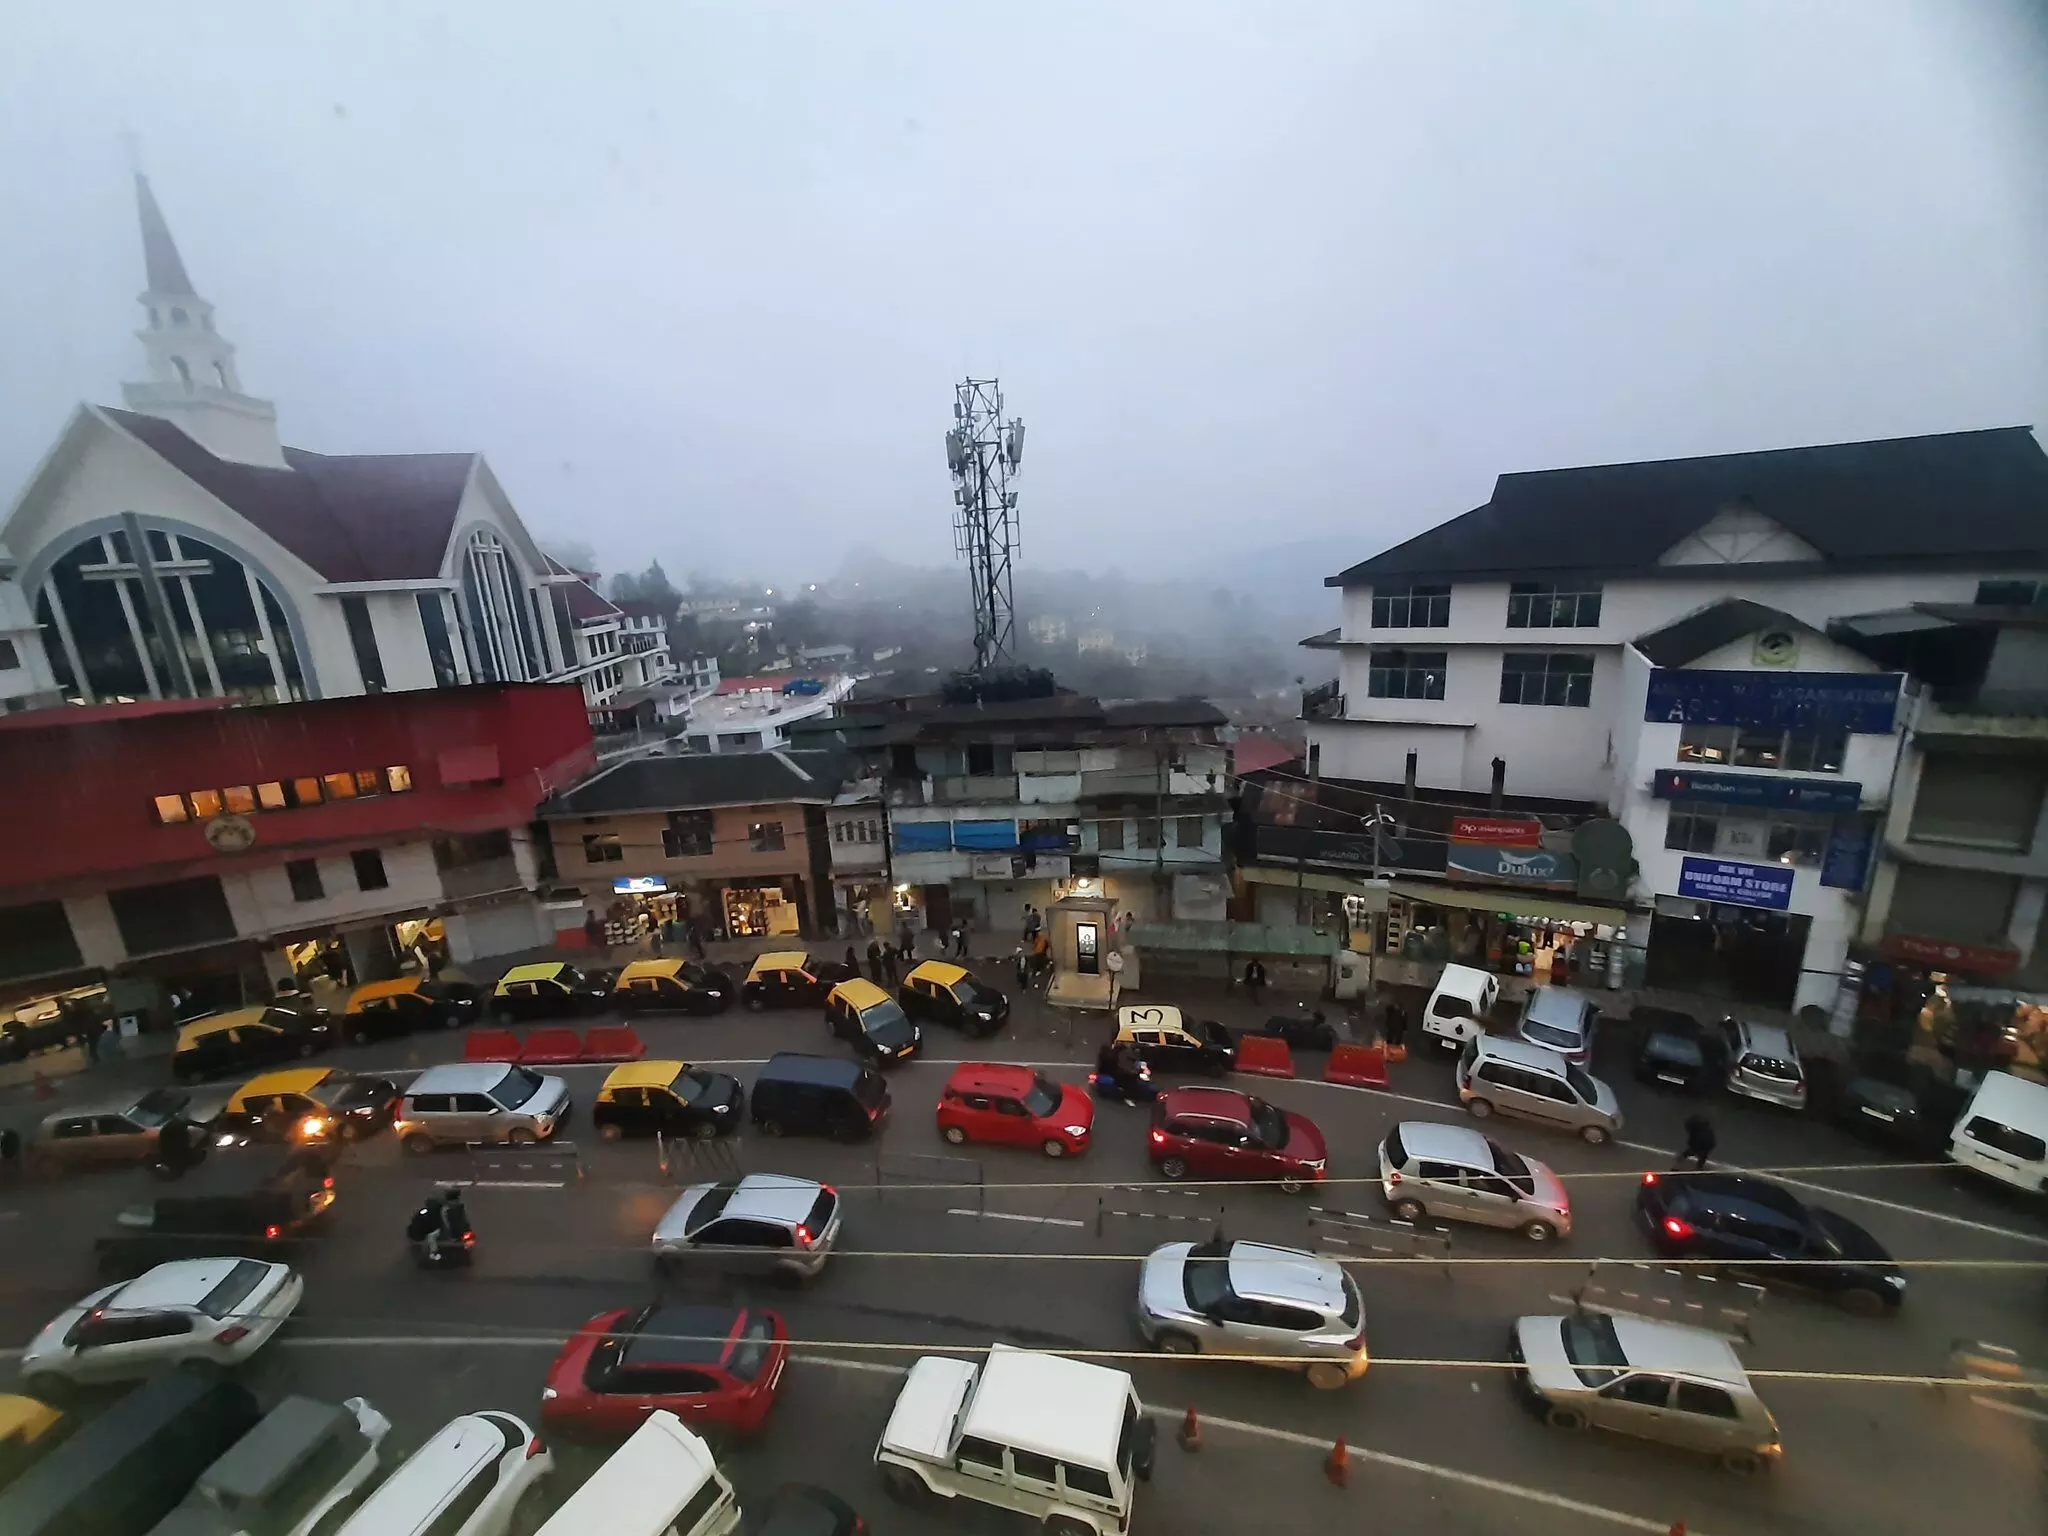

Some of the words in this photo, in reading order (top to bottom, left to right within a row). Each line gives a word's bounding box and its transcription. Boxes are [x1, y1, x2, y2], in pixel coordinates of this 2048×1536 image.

[1498, 861, 1549, 877] Dulux
[1684, 870, 1743, 887] UNIFORM
[1744, 878, 1788, 893] STORE
